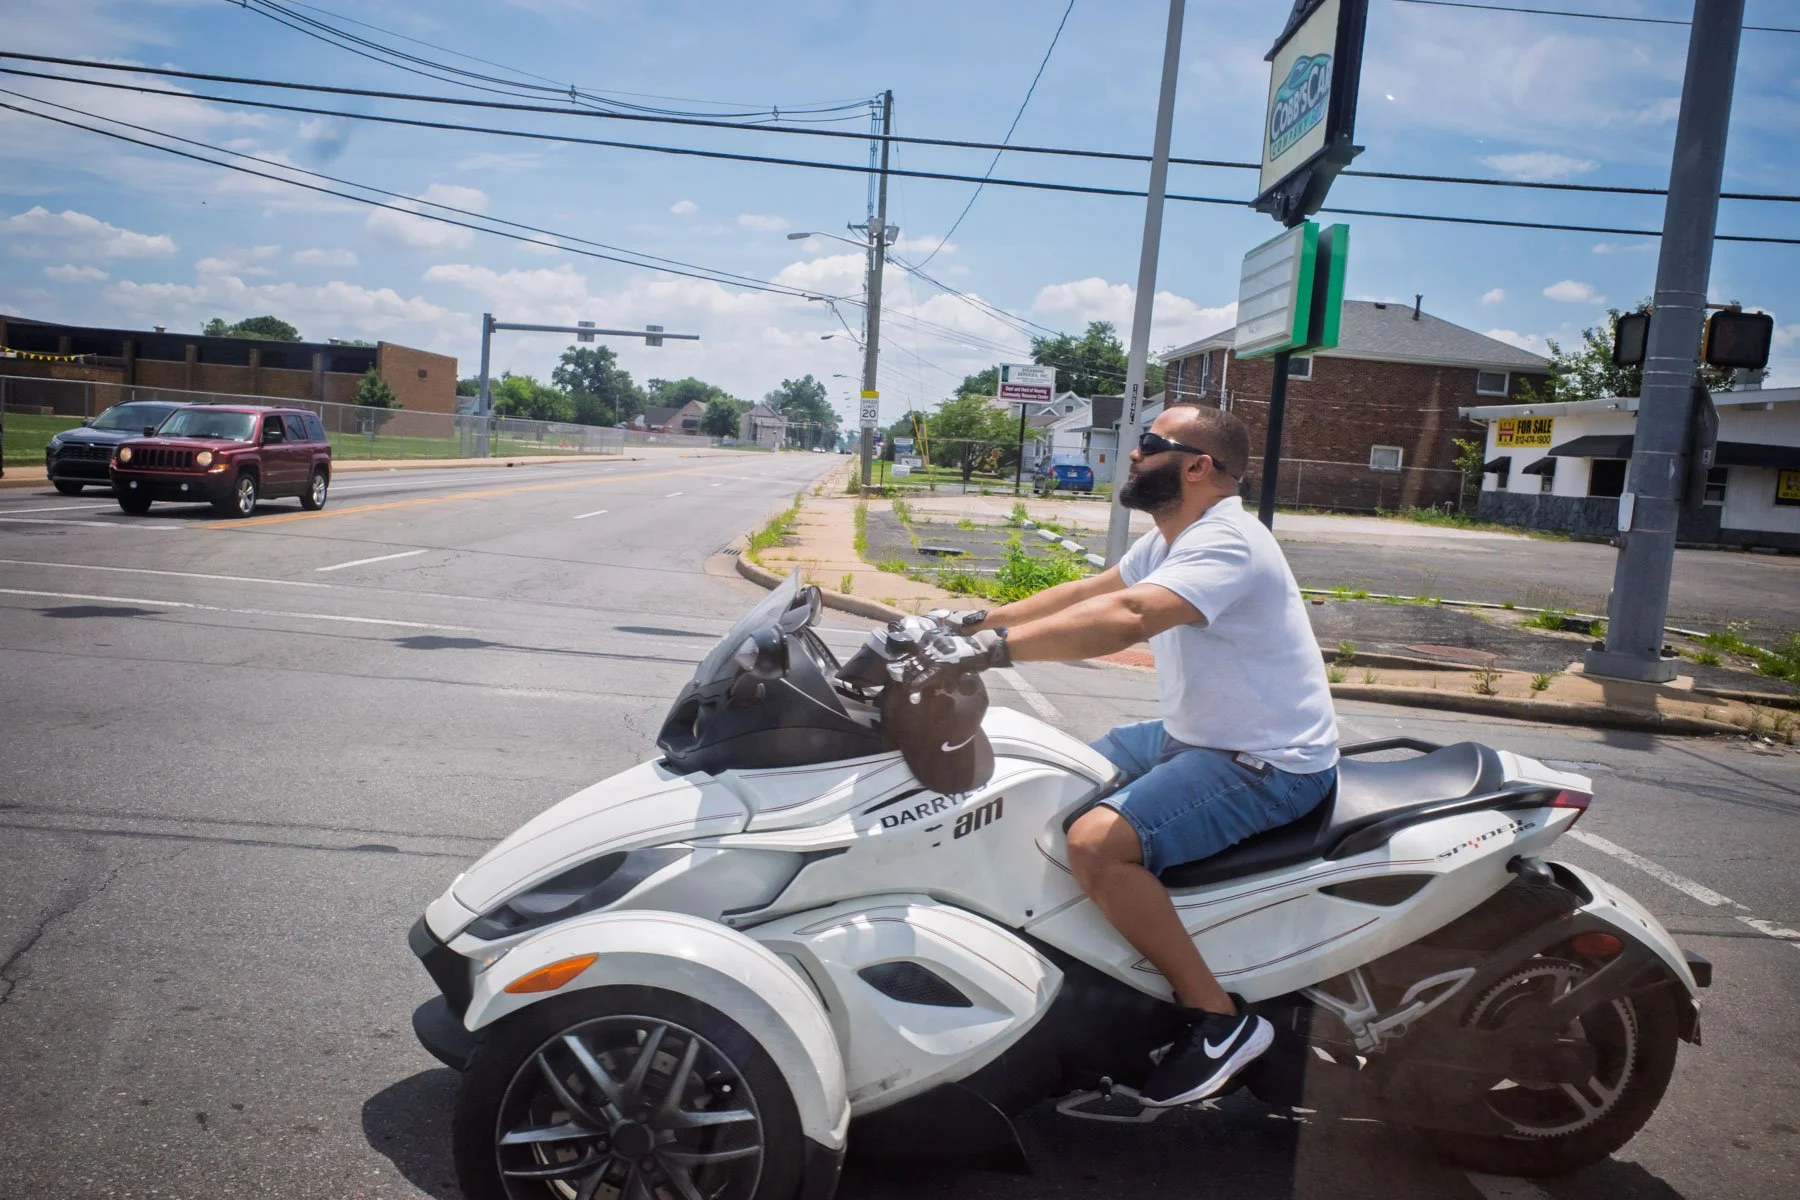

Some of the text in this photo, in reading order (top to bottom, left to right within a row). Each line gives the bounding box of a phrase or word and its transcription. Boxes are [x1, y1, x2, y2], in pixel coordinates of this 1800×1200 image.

[862, 409, 877, 418] 20
[1517, 419, 1553, 434] FOR SALE
[1512, 822, 1536, 835] RS
[1437, 820, 1523, 860] SPYDER
